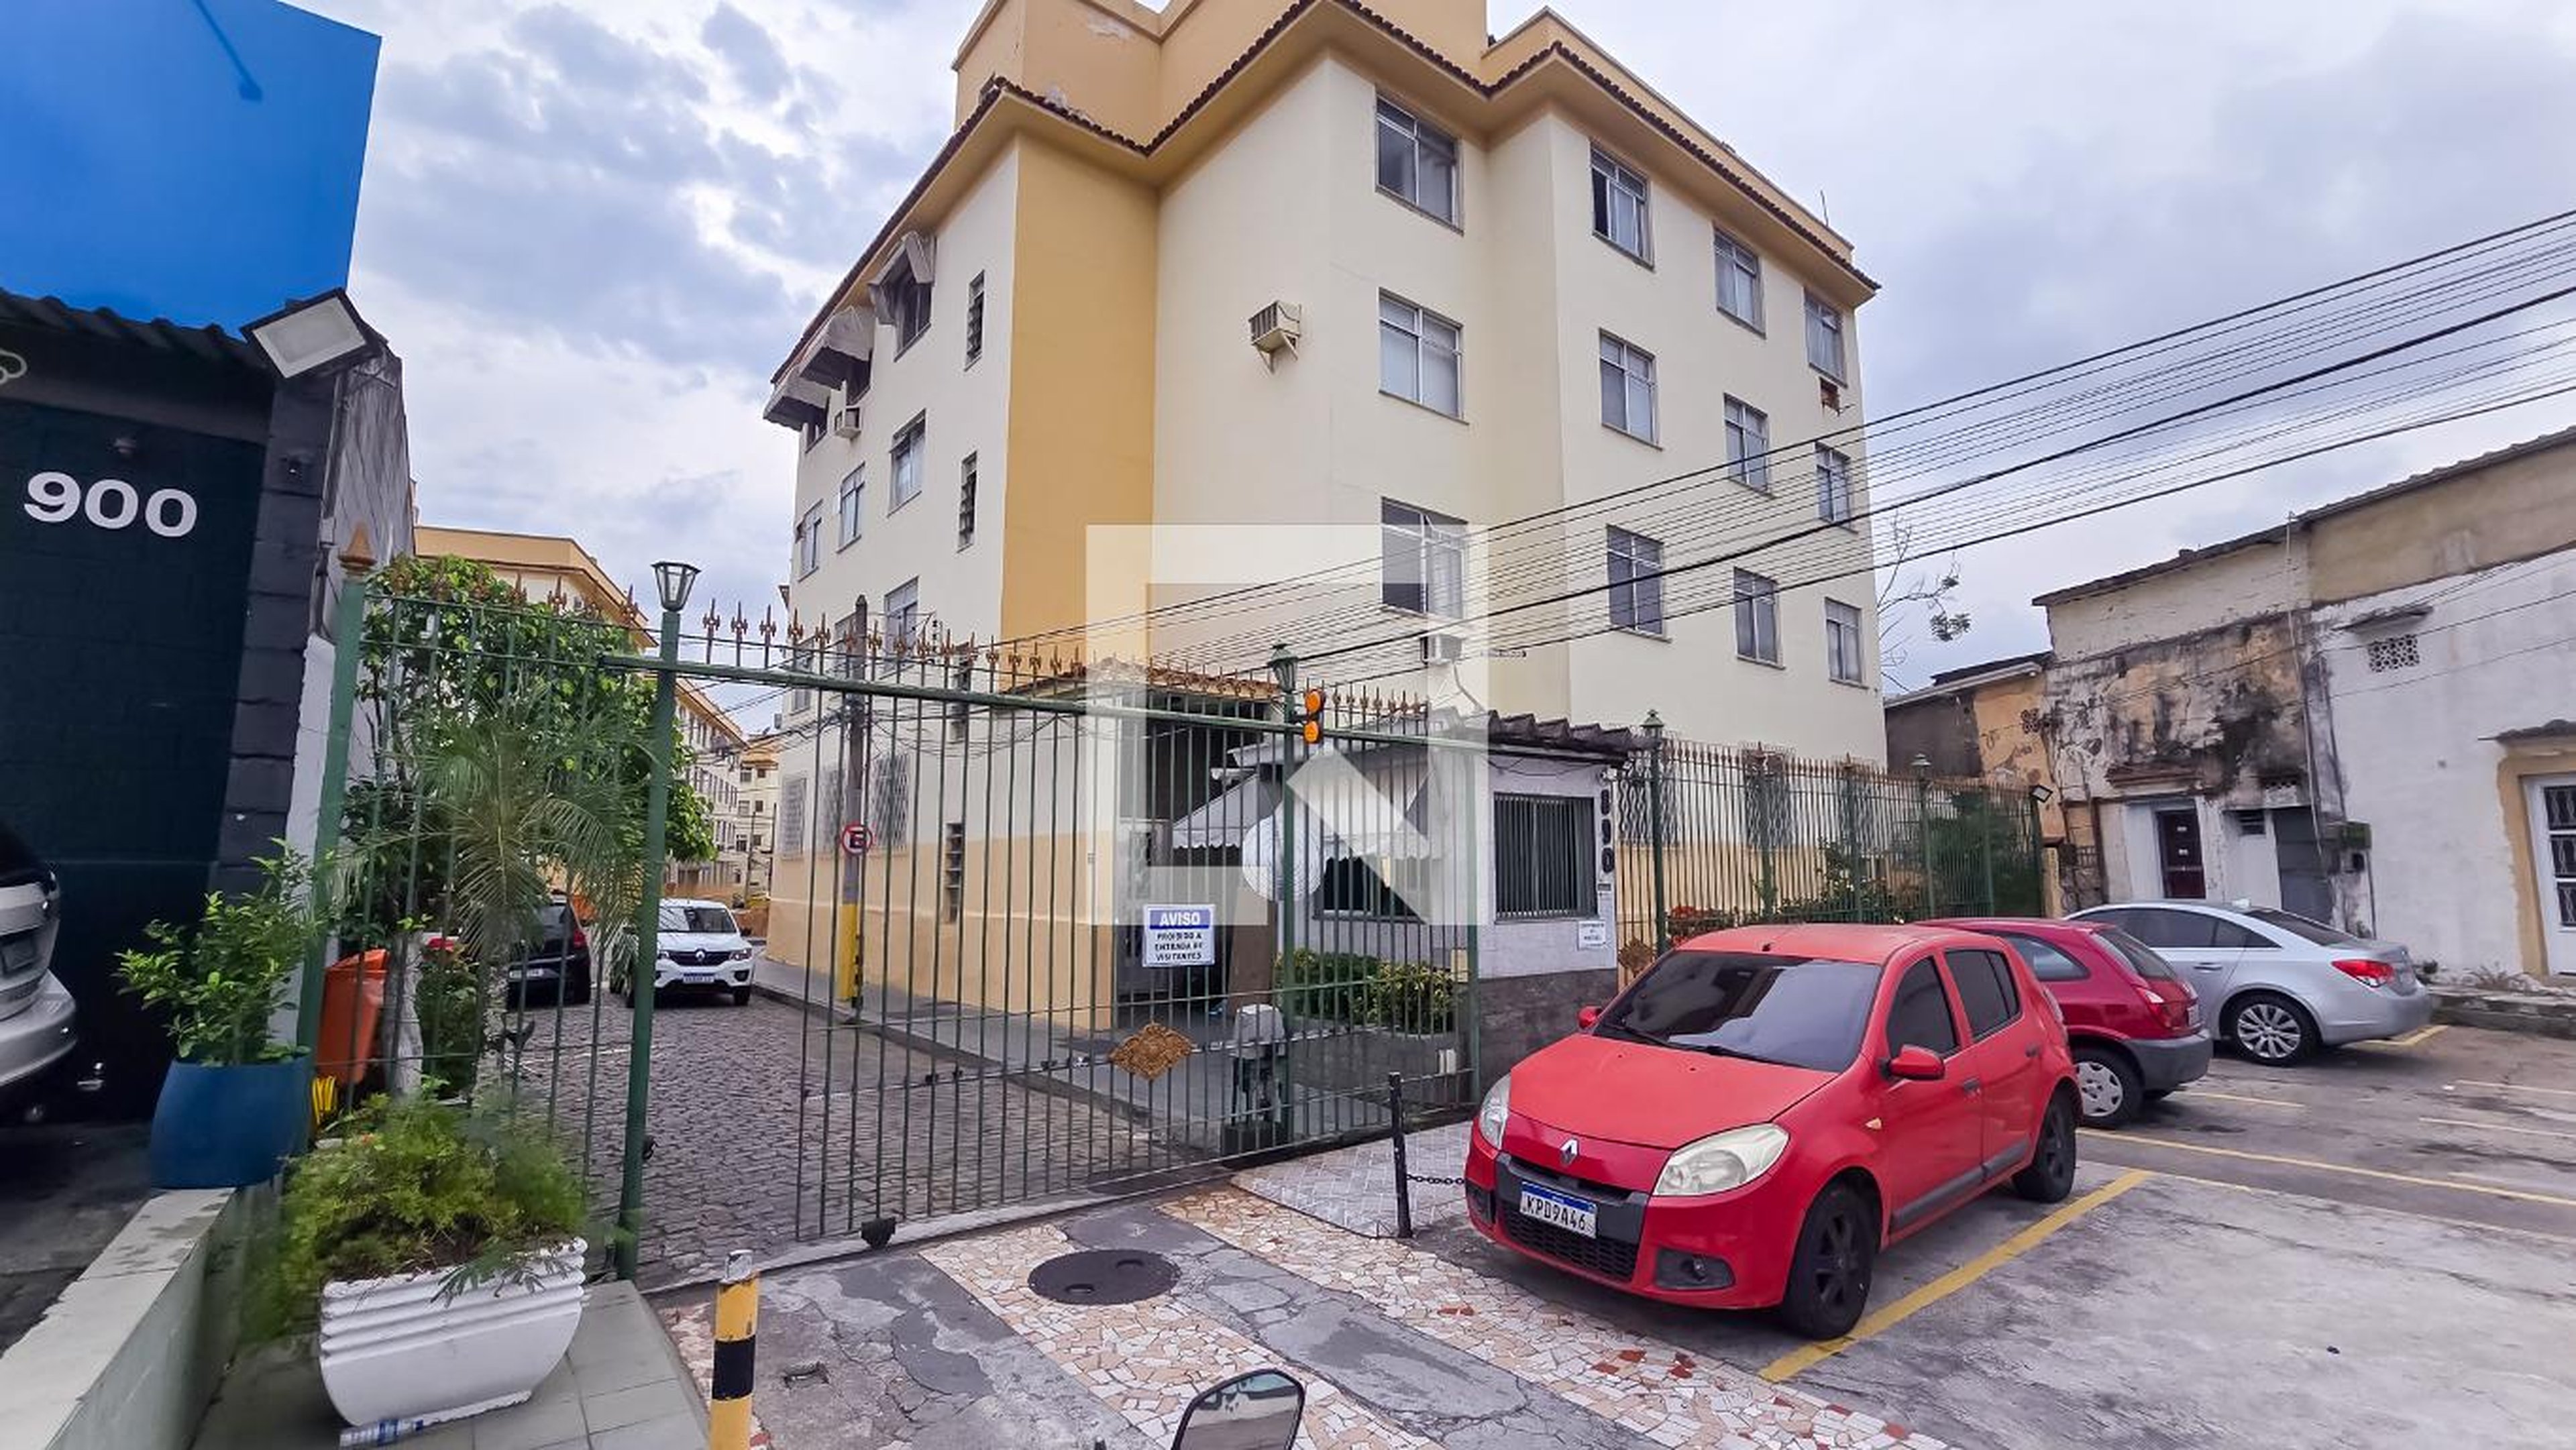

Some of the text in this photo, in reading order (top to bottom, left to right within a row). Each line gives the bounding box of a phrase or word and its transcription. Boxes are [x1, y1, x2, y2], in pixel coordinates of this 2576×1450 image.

[24, 471, 197, 537] 900
[1159, 912, 1201, 926] AVISO
[1156, 952, 1201, 961] VISITANTES
[1526, 1194, 1586, 1231] KPD9A46
